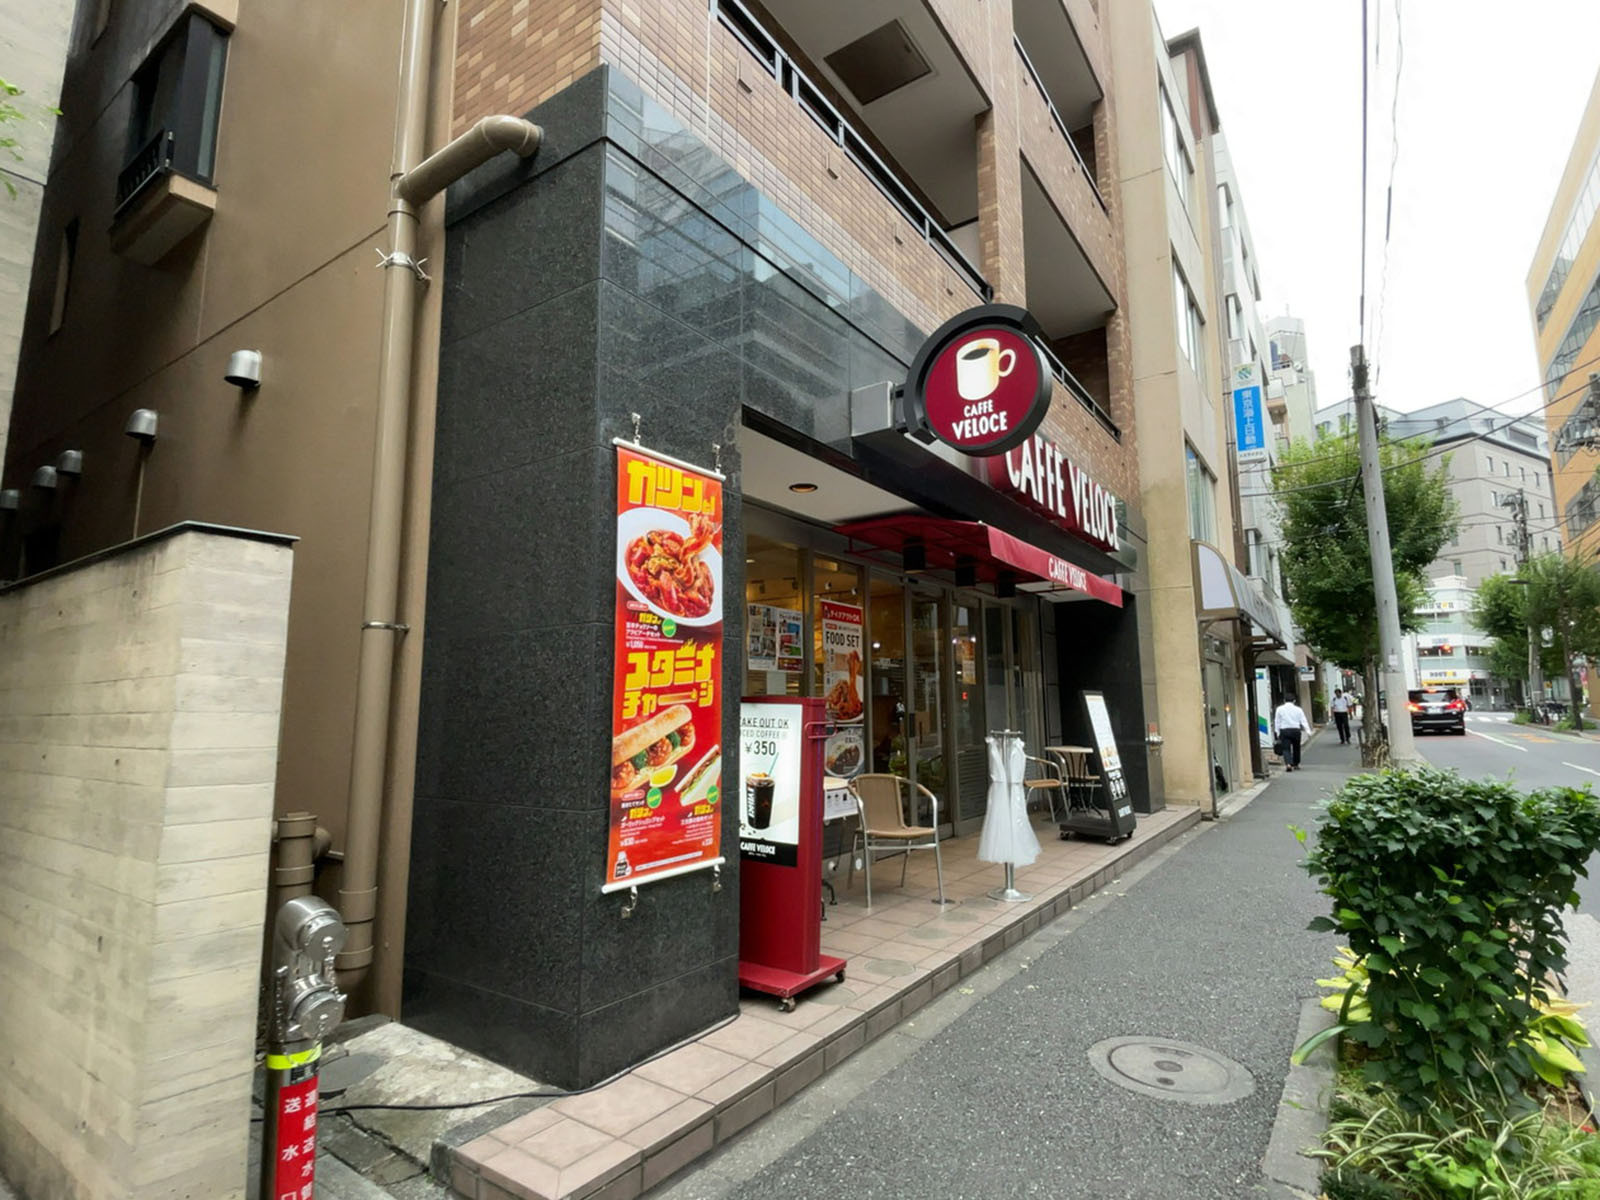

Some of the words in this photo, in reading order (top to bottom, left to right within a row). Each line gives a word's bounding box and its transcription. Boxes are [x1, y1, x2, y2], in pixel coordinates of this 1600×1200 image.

[963, 399, 993, 418] CAFFE
[951, 410, 1008, 440] VELOCE
[1067, 459, 1120, 551] VELOCE
[1048, 557, 1068, 584] CAFFE
[825, 631, 846, 647] FOOD
[846, 634, 861, 649] SET
[625, 641, 715, 690] スタミナ
[621, 679, 715, 720] チャージ
[740, 716, 758, 729] AKE
[759, 717, 776, 729] OUT
[777, 718, 790, 729] OK
[744, 739, 777, 757] ¥350
